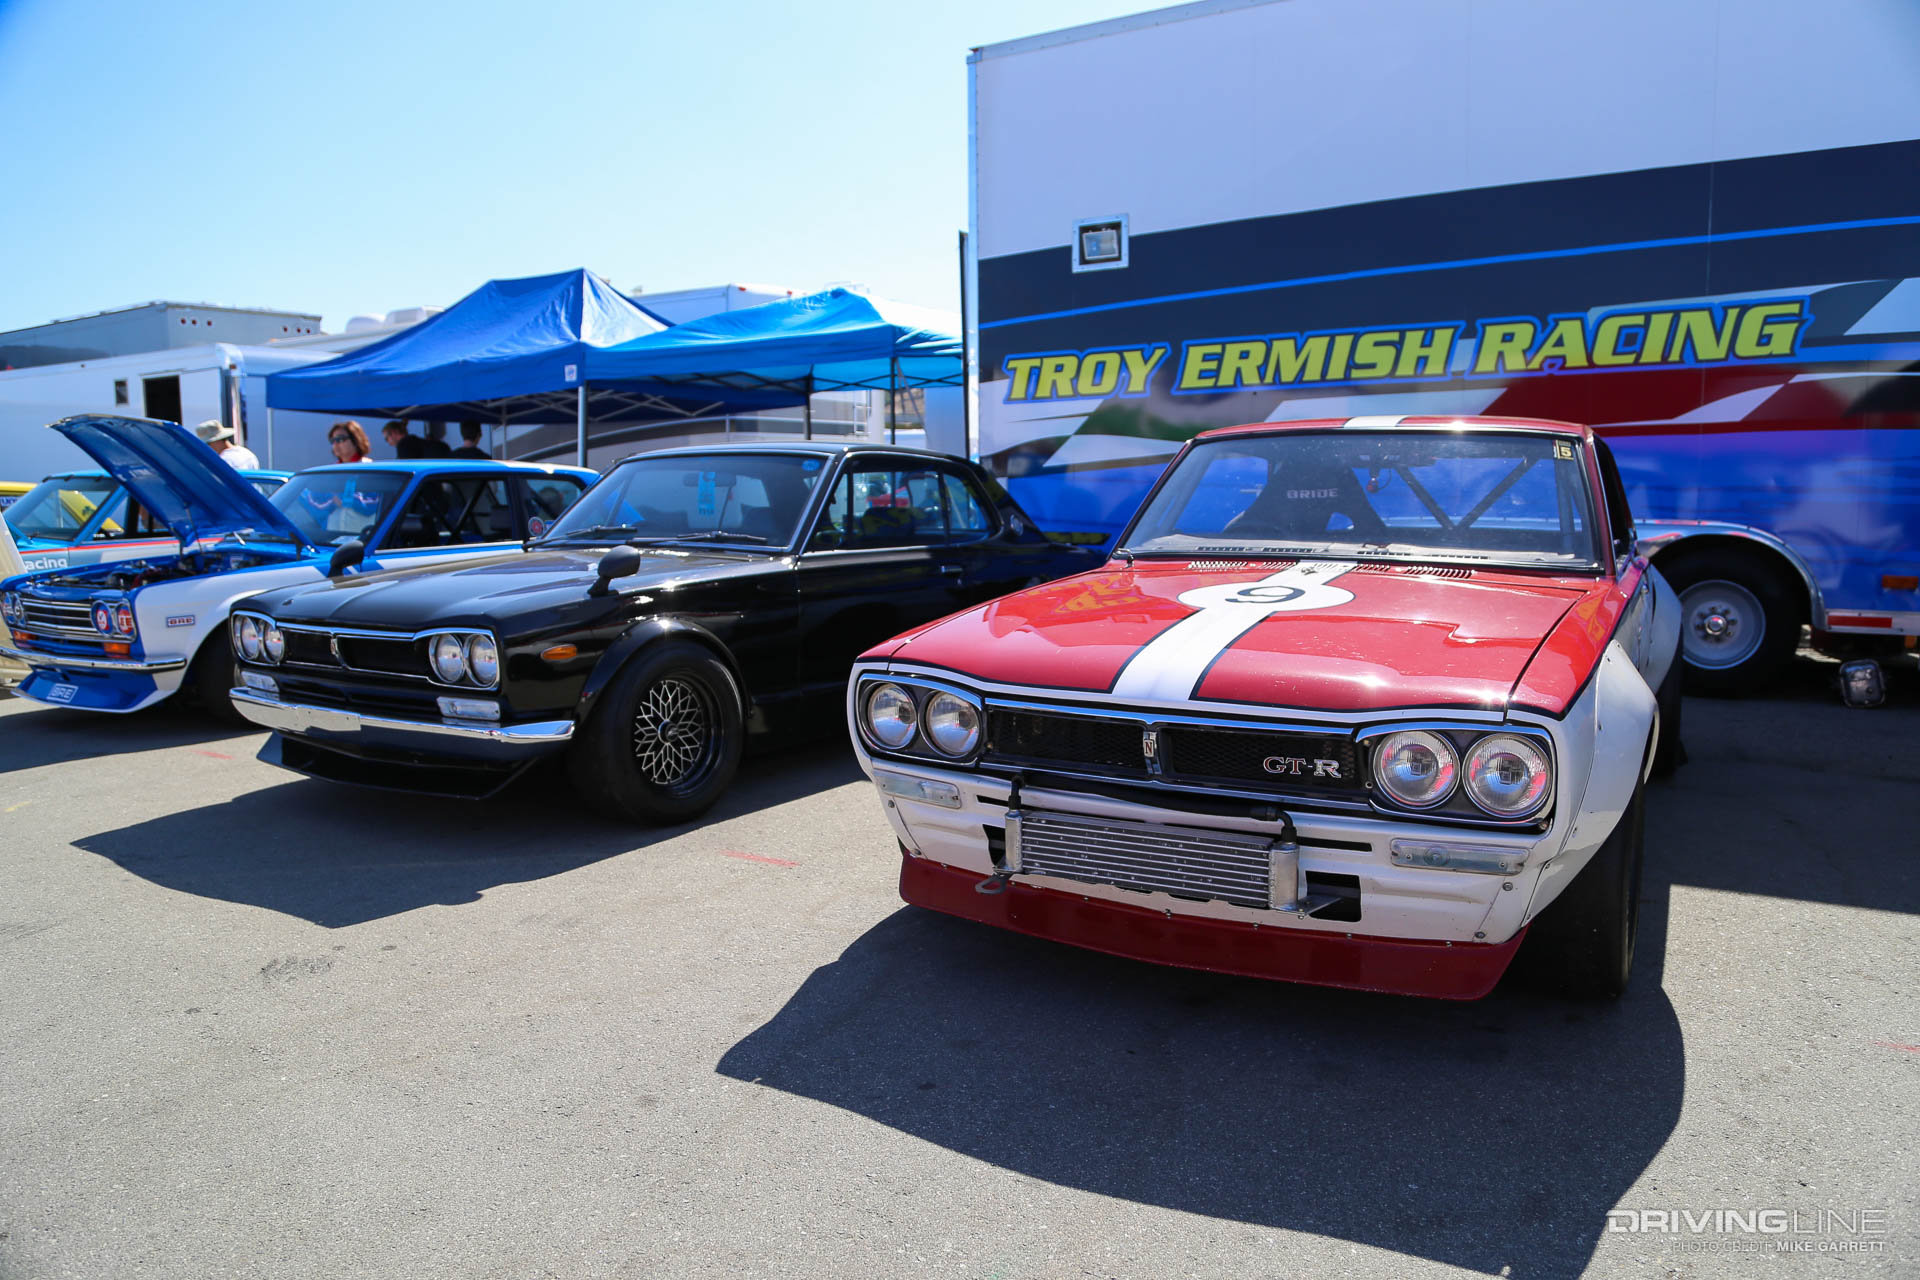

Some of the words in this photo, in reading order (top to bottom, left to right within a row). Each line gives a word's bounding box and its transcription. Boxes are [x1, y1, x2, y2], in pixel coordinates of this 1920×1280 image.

[1005, 347, 1168, 400] TROY
[1178, 326, 1456, 390] ERMISH
[1473, 302, 1802, 374] RACING
[1286, 488, 1339, 499] BRIDE
[24, 557, 68, 570] acing
[1225, 585, 1306, 604] 9
[1263, 756, 1341, 778] GT-R
